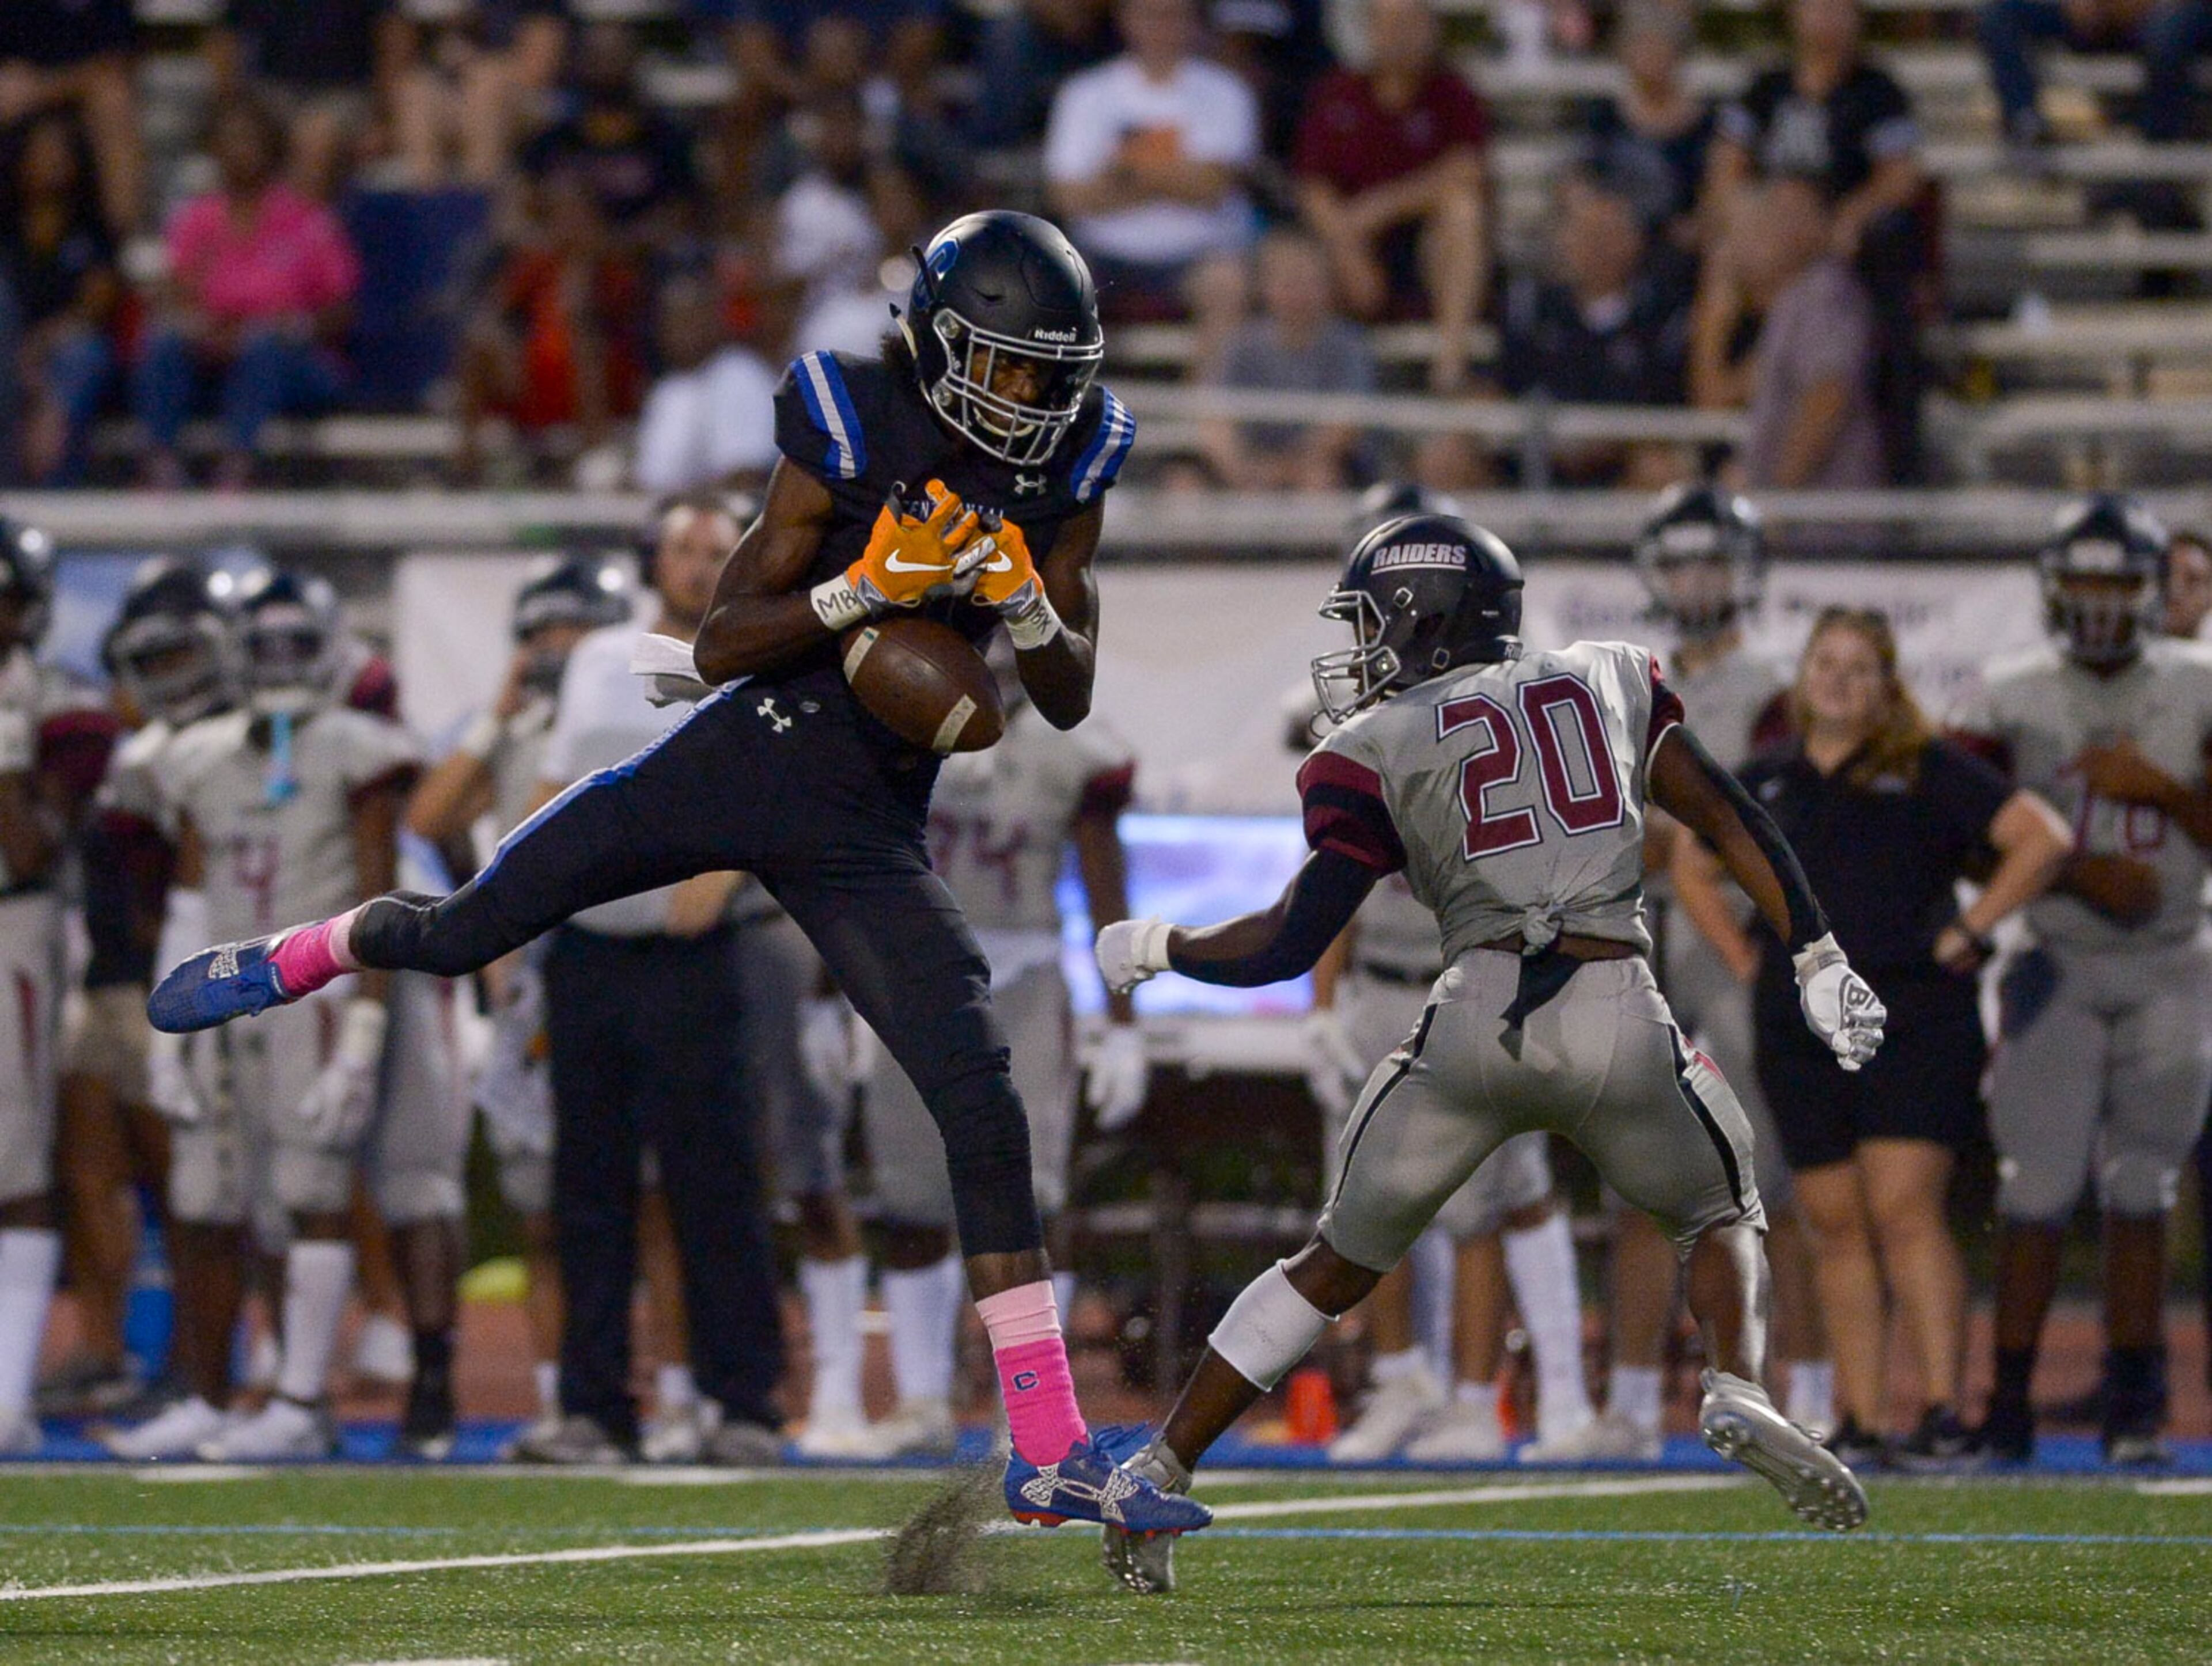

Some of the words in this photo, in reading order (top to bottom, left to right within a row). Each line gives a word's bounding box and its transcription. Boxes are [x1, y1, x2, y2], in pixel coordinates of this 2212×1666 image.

[1035, 327, 1077, 343] Riddell
[1372, 544, 1466, 568] RAIDERS
[1435, 672, 1625, 864] 20
[1012, 1371, 1040, 1392] C
